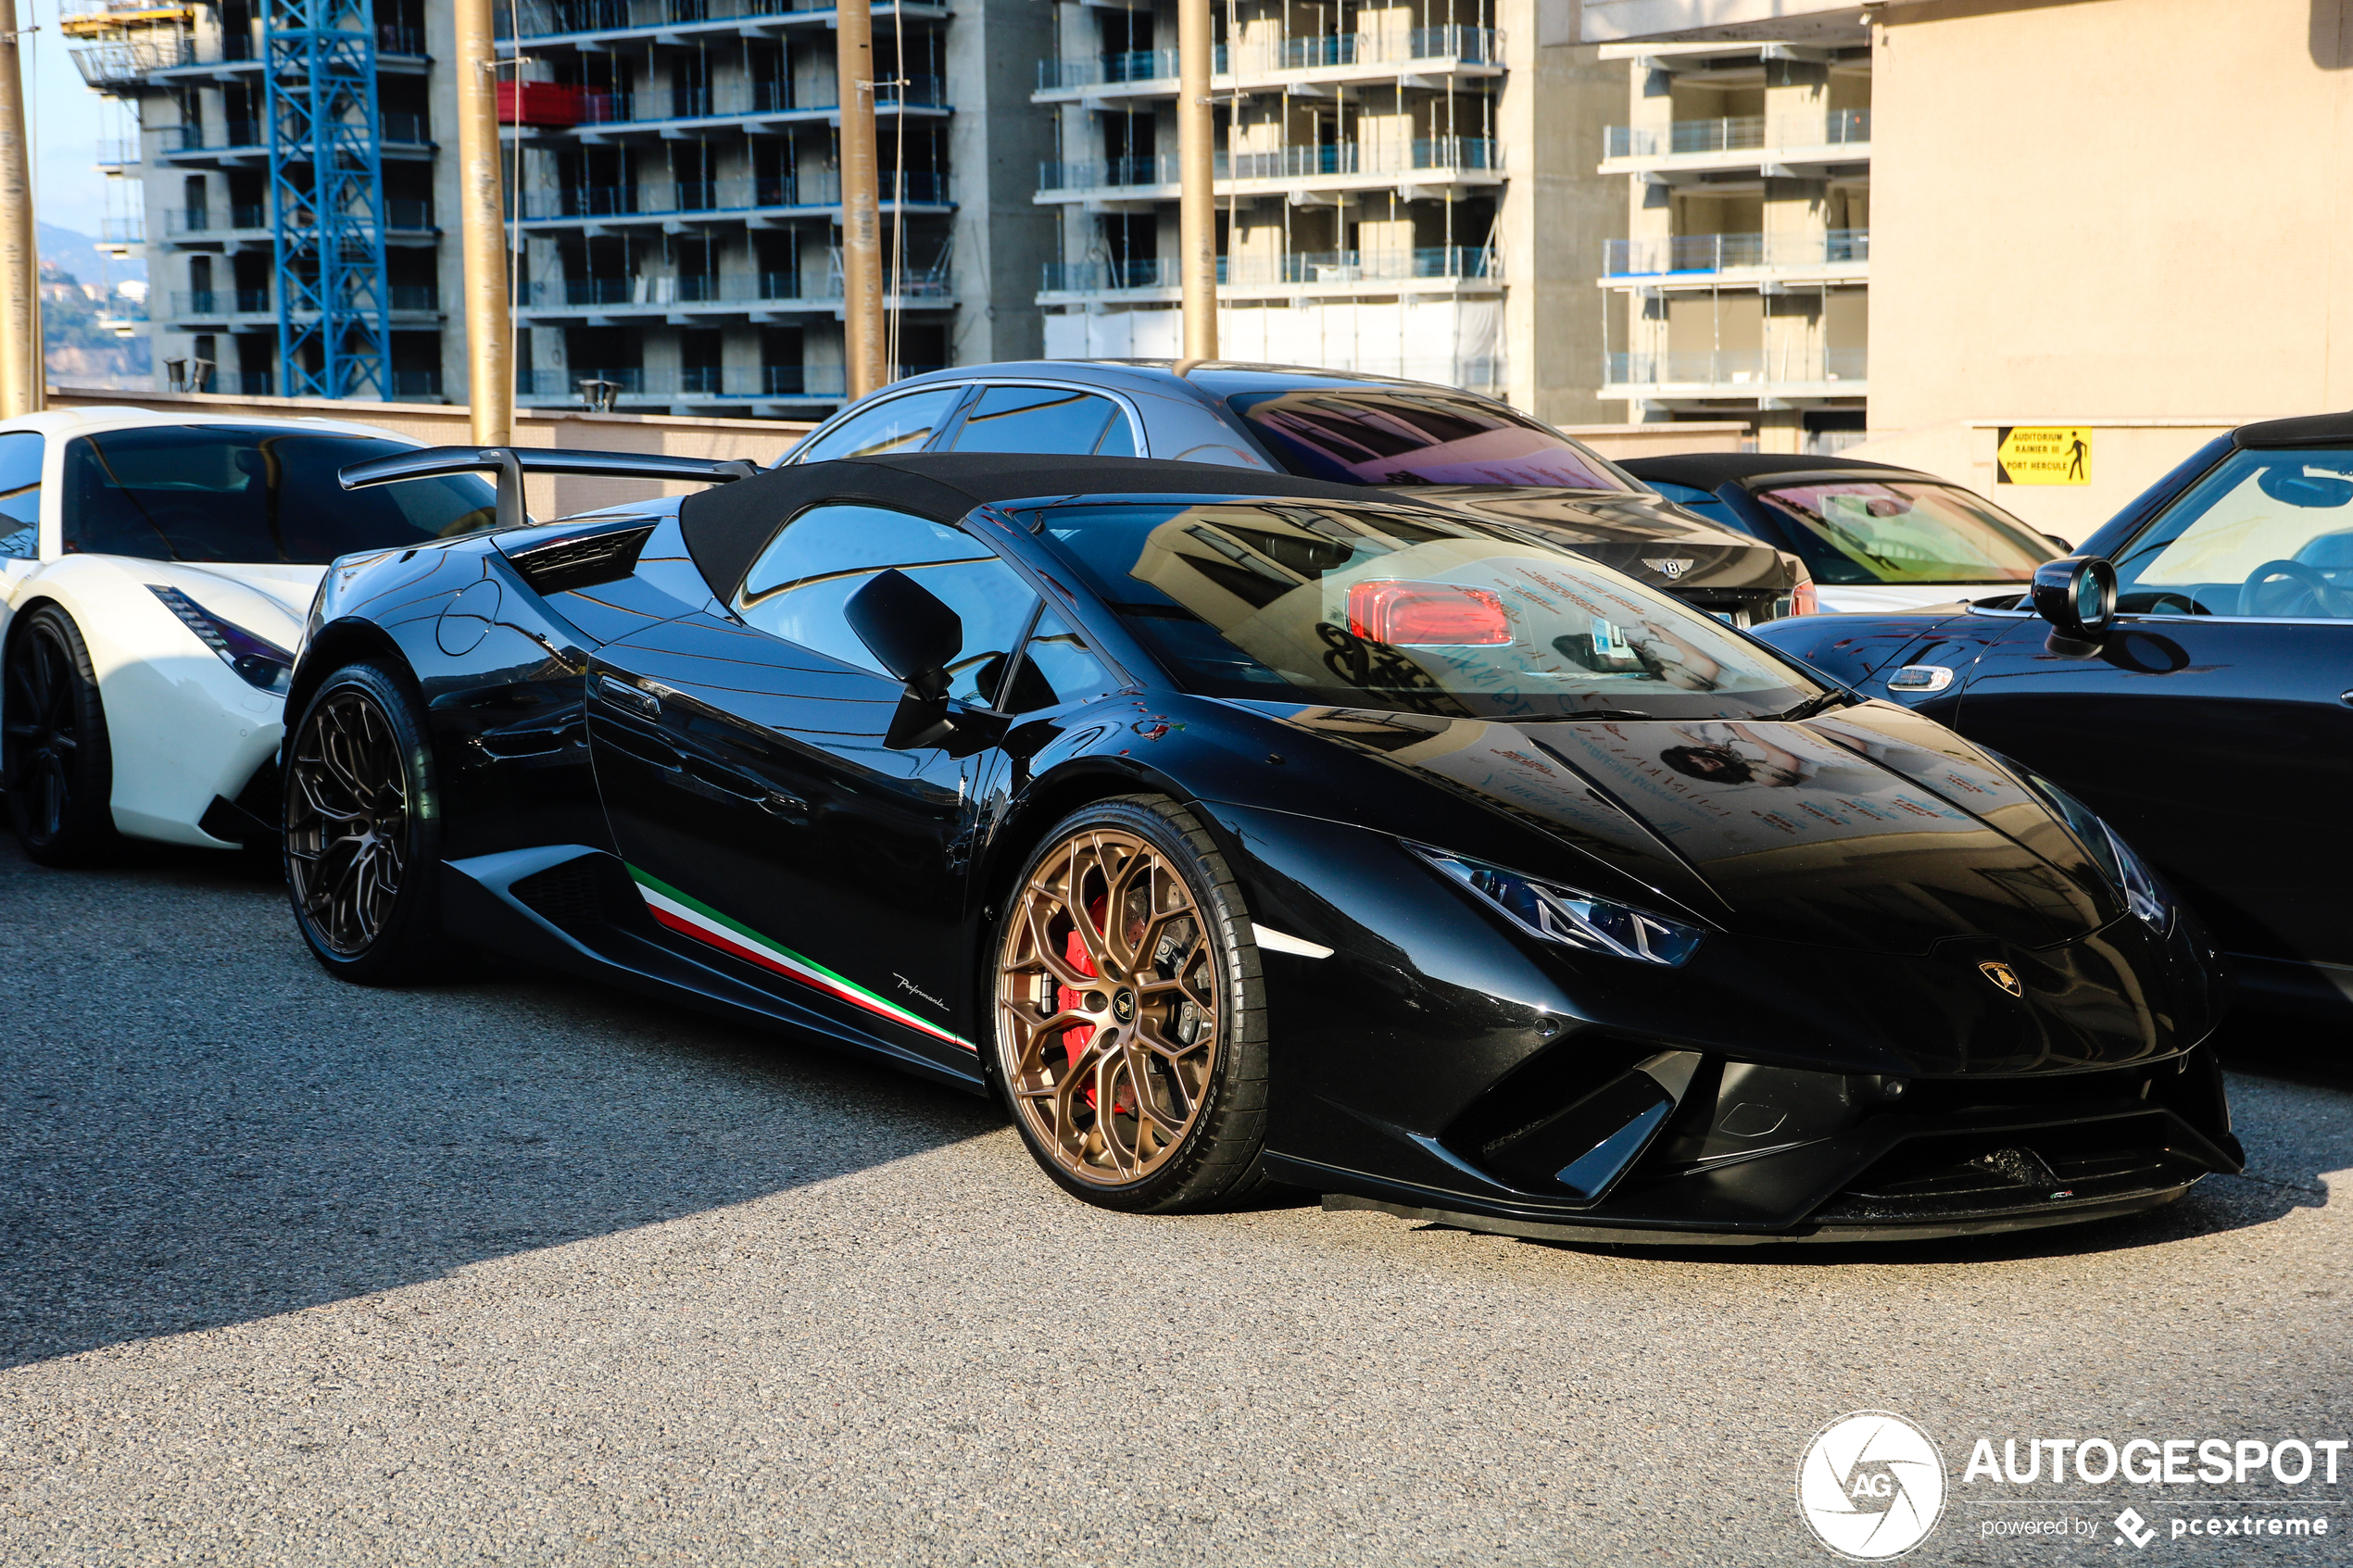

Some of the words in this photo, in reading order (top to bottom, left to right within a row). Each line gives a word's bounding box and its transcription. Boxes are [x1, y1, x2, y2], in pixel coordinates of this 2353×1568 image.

[2013, 433, 2063, 442] AUDITORIUM
[2015, 445, 2048, 454] RAINIER
[2007, 462, 2027, 470] PORT
[2031, 462, 2068, 470] HERCULE
[892, 972, 950, 1011] Performante
